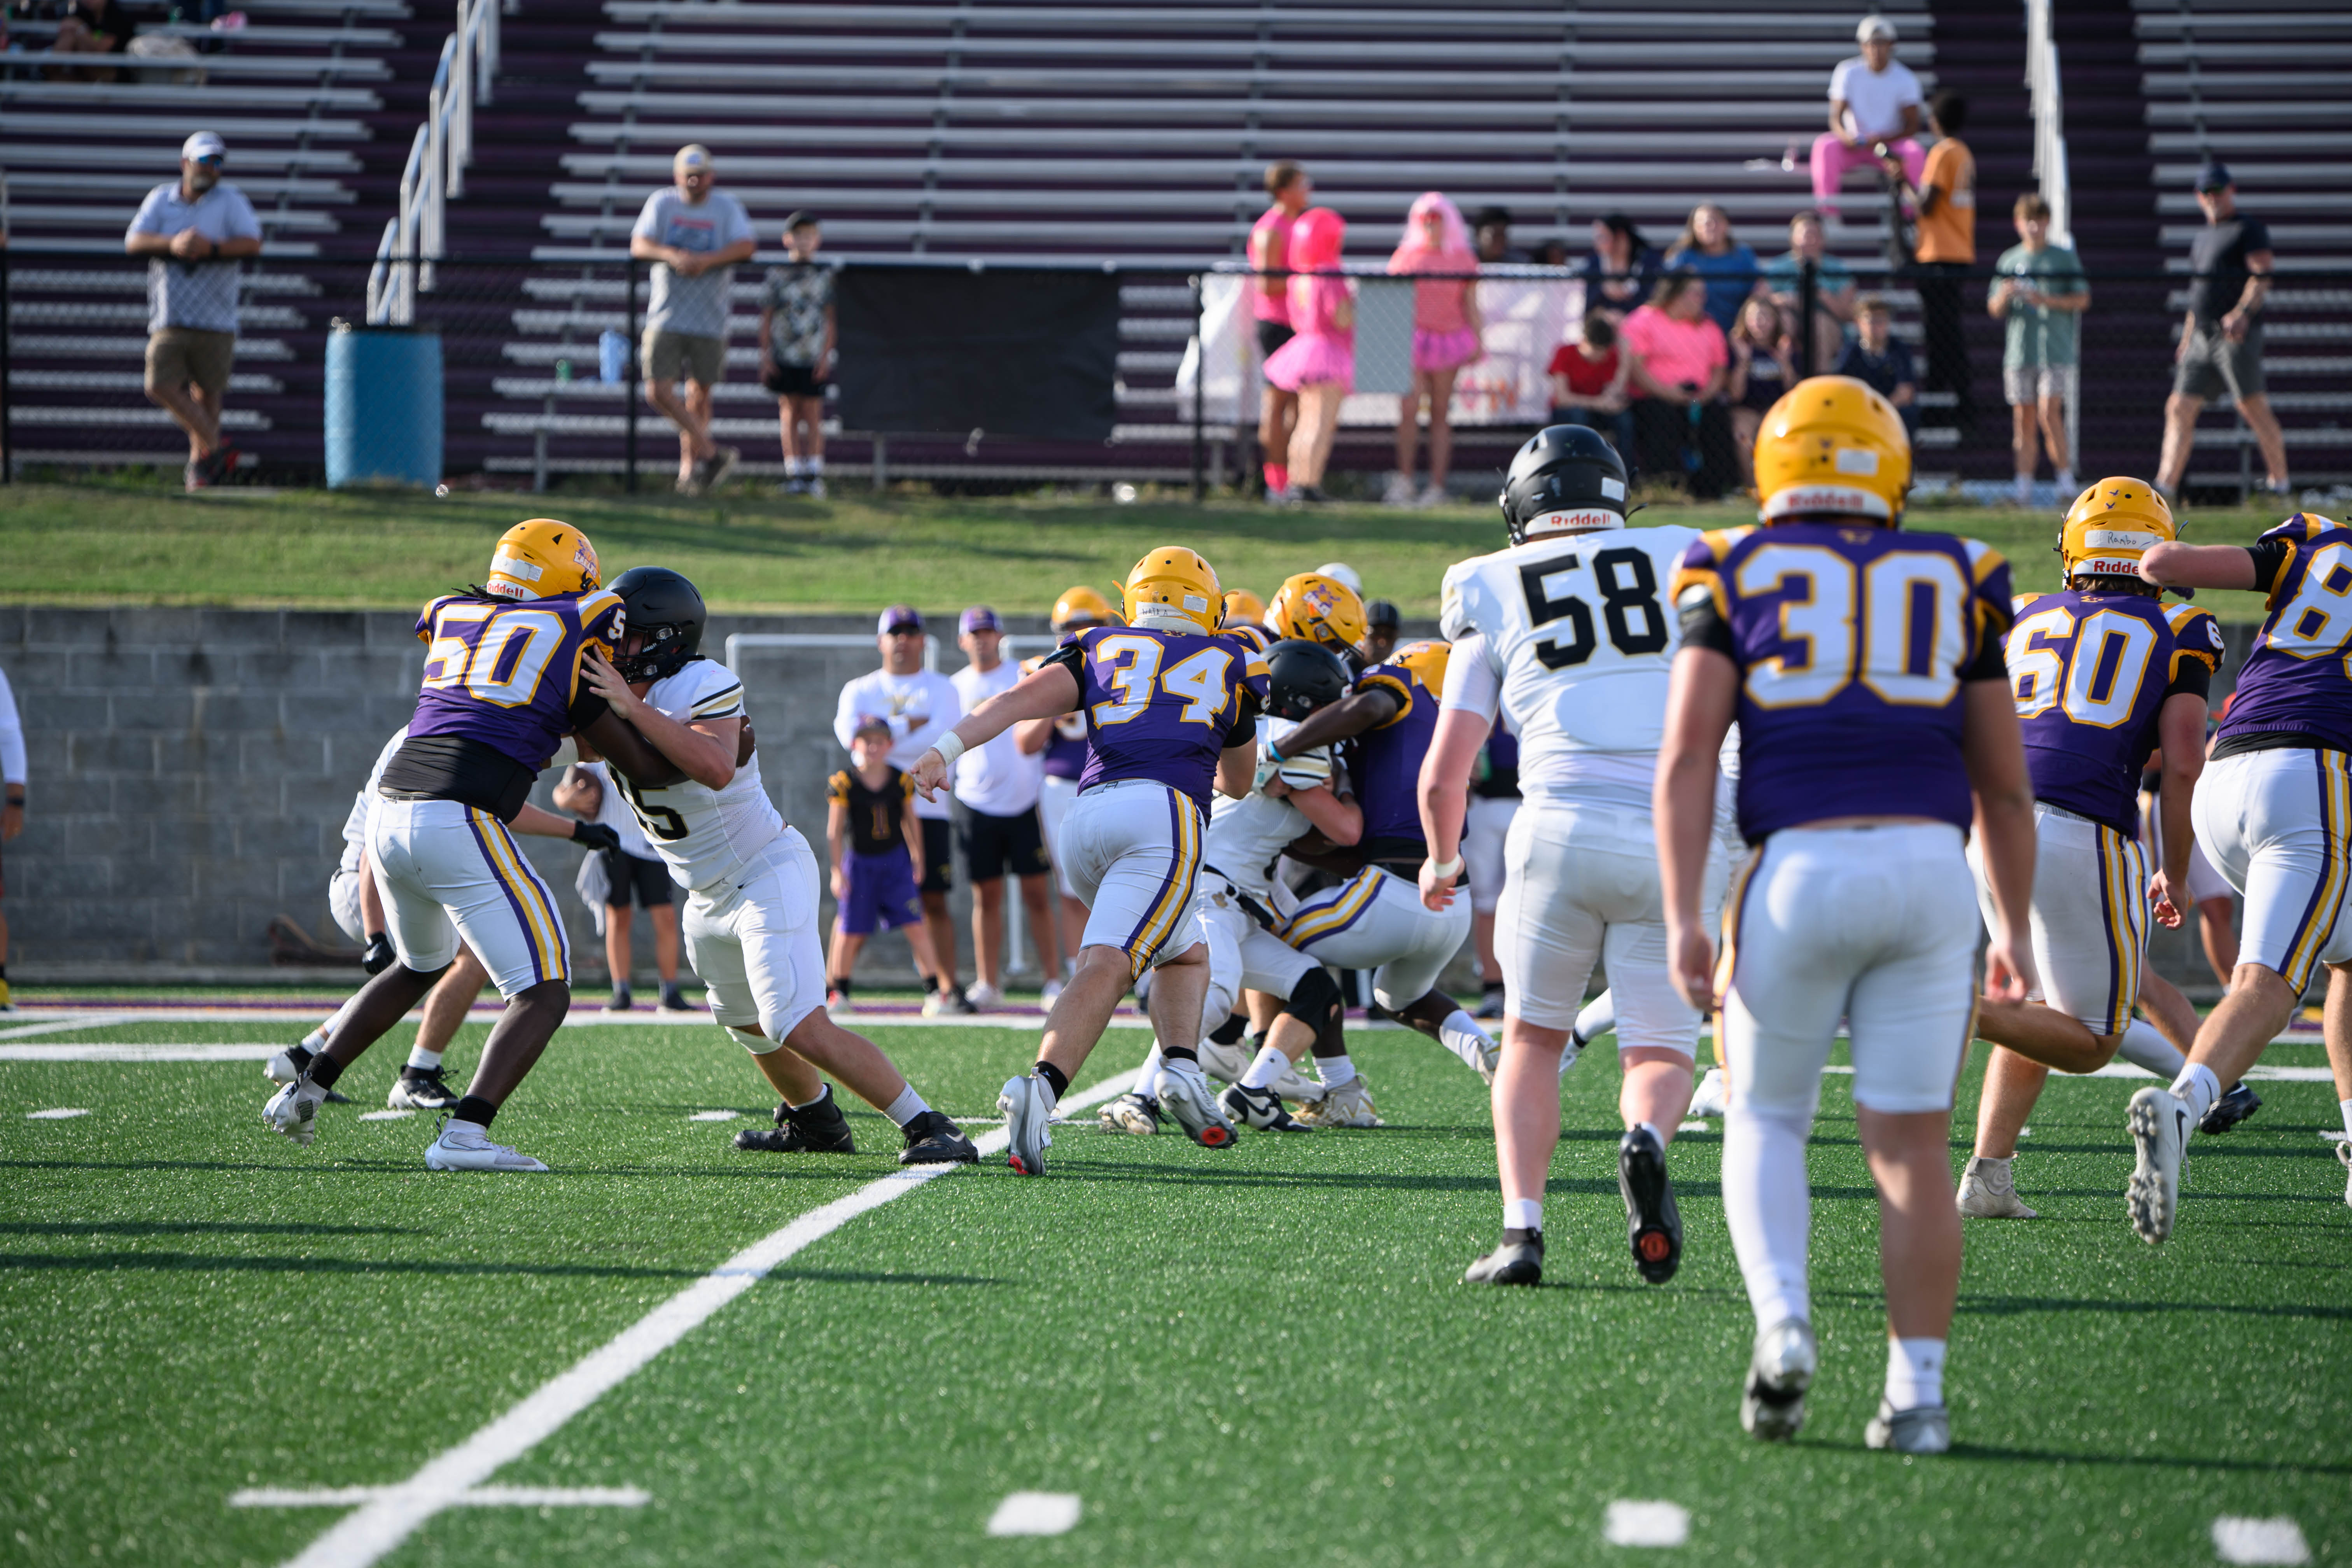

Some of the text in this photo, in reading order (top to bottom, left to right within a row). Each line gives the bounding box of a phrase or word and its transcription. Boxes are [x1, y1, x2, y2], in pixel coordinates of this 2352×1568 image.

[1551, 513, 1610, 525] Riddell
[2094, 561, 2139, 575] Ridde
[488, 583, 523, 598] Riddell
[607, 608, 626, 640] 5
[1517, 546, 1671, 673] 58
[1734, 544, 1969, 710] 30
[2266, 541, 2352, 681] 8
[422, 604, 567, 708] 50
[1091, 634, 1234, 730] 34
[2004, 606, 2158, 730] 60
